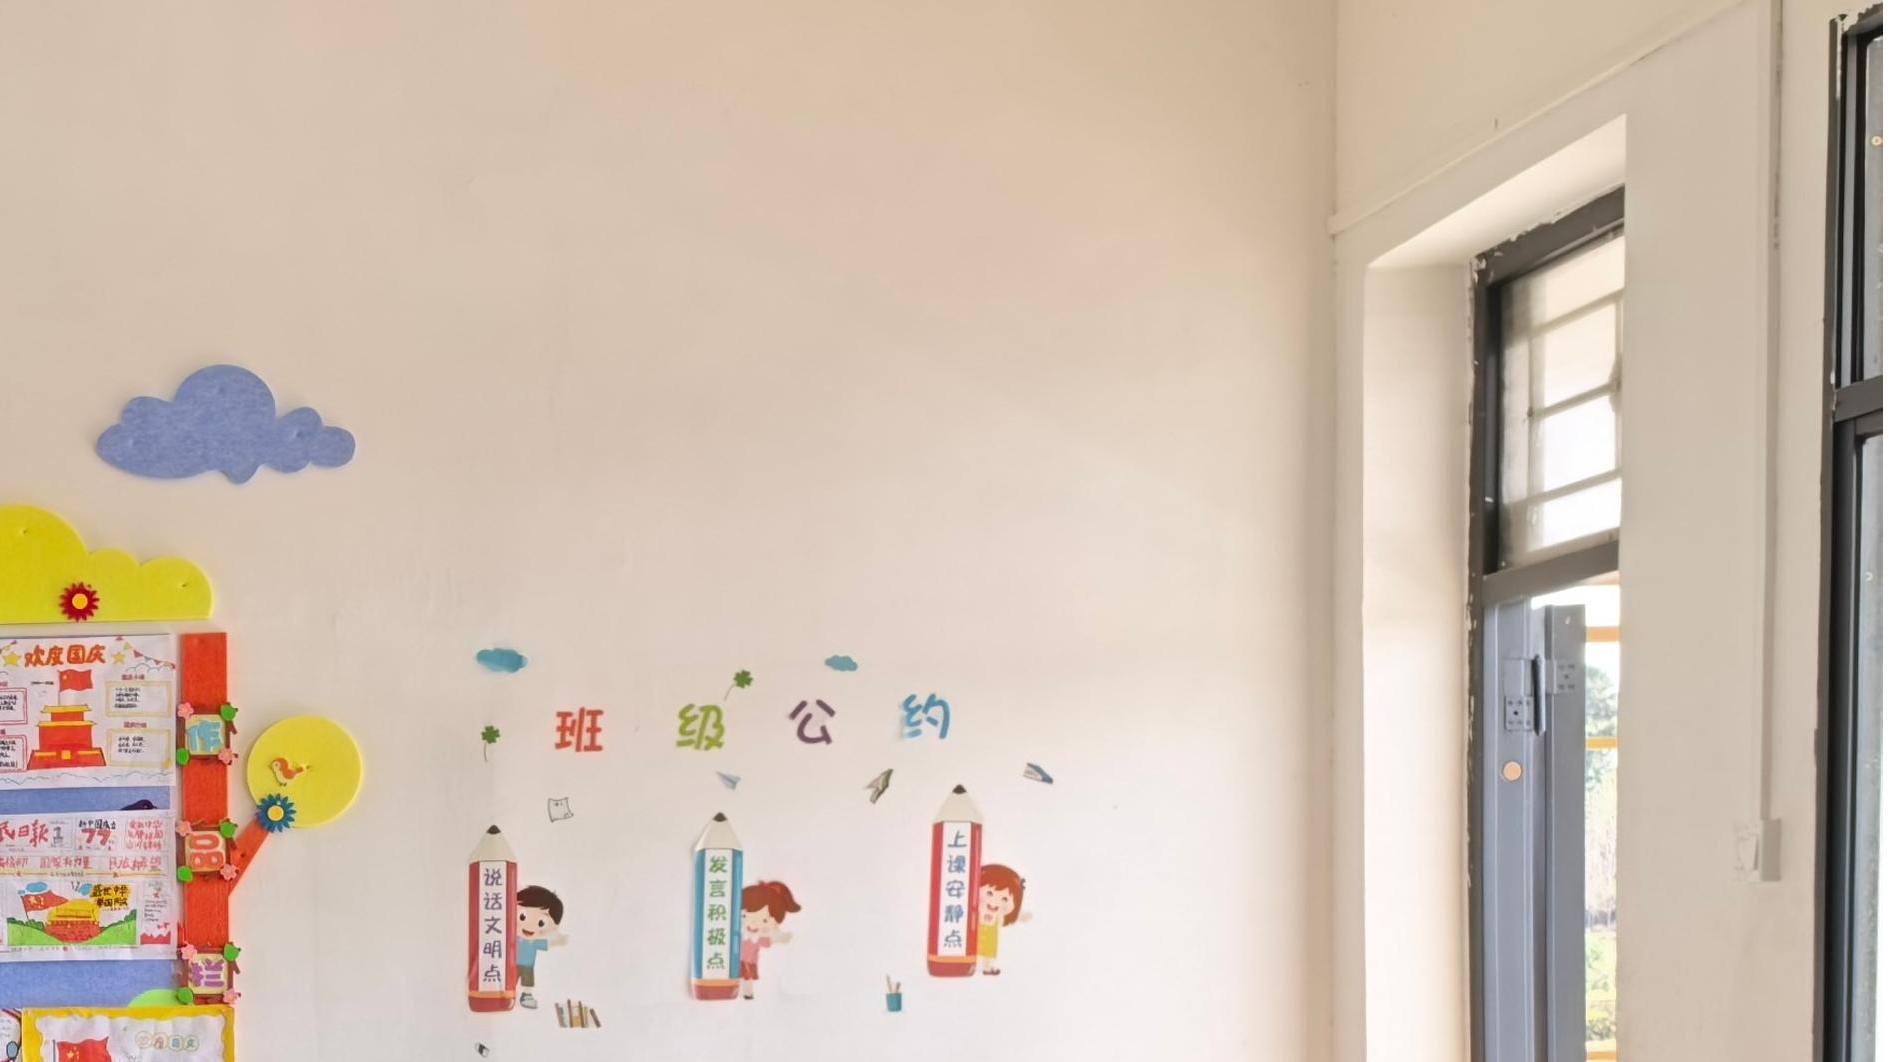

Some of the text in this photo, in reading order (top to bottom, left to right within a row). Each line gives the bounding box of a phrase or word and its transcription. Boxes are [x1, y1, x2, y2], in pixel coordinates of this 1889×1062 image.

[24, 644, 106, 667] 欢度国庆
[555, 693, 950, 752] 班级公约
[81, 828, 111, 846] 77
[483, 868, 503, 982] 说话文明点
